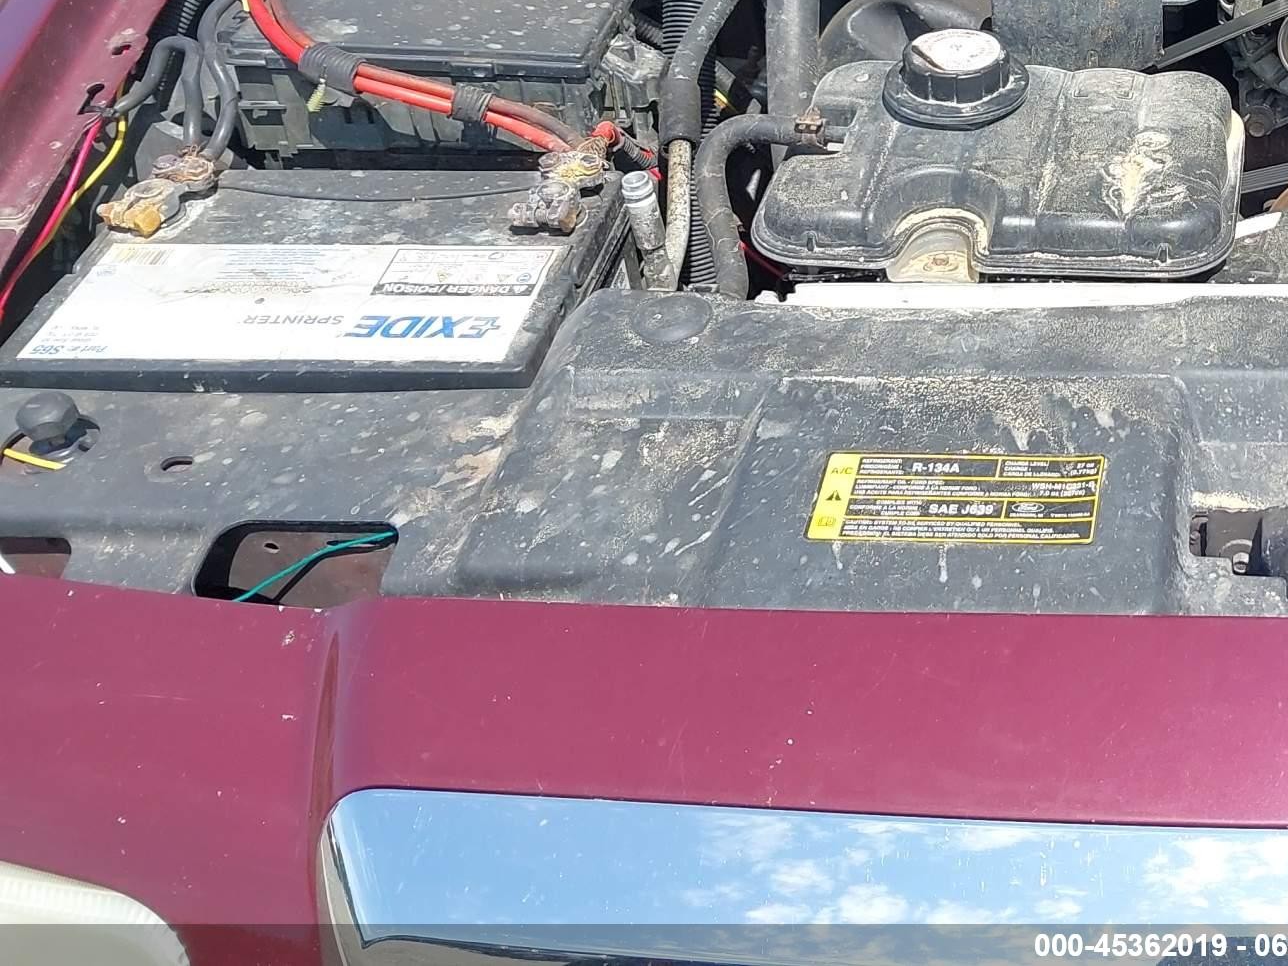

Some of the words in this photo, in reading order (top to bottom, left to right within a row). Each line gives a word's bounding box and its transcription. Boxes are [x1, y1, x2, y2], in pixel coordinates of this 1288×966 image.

[245, 314, 344, 325] SPRINTER
[343, 315, 500, 339] EXIDE
[30, 344, 65, 355] S65
[910, 462, 961, 472] R-134A
[927, 503, 958, 514] SAE
[960, 504, 994, 515] J639
